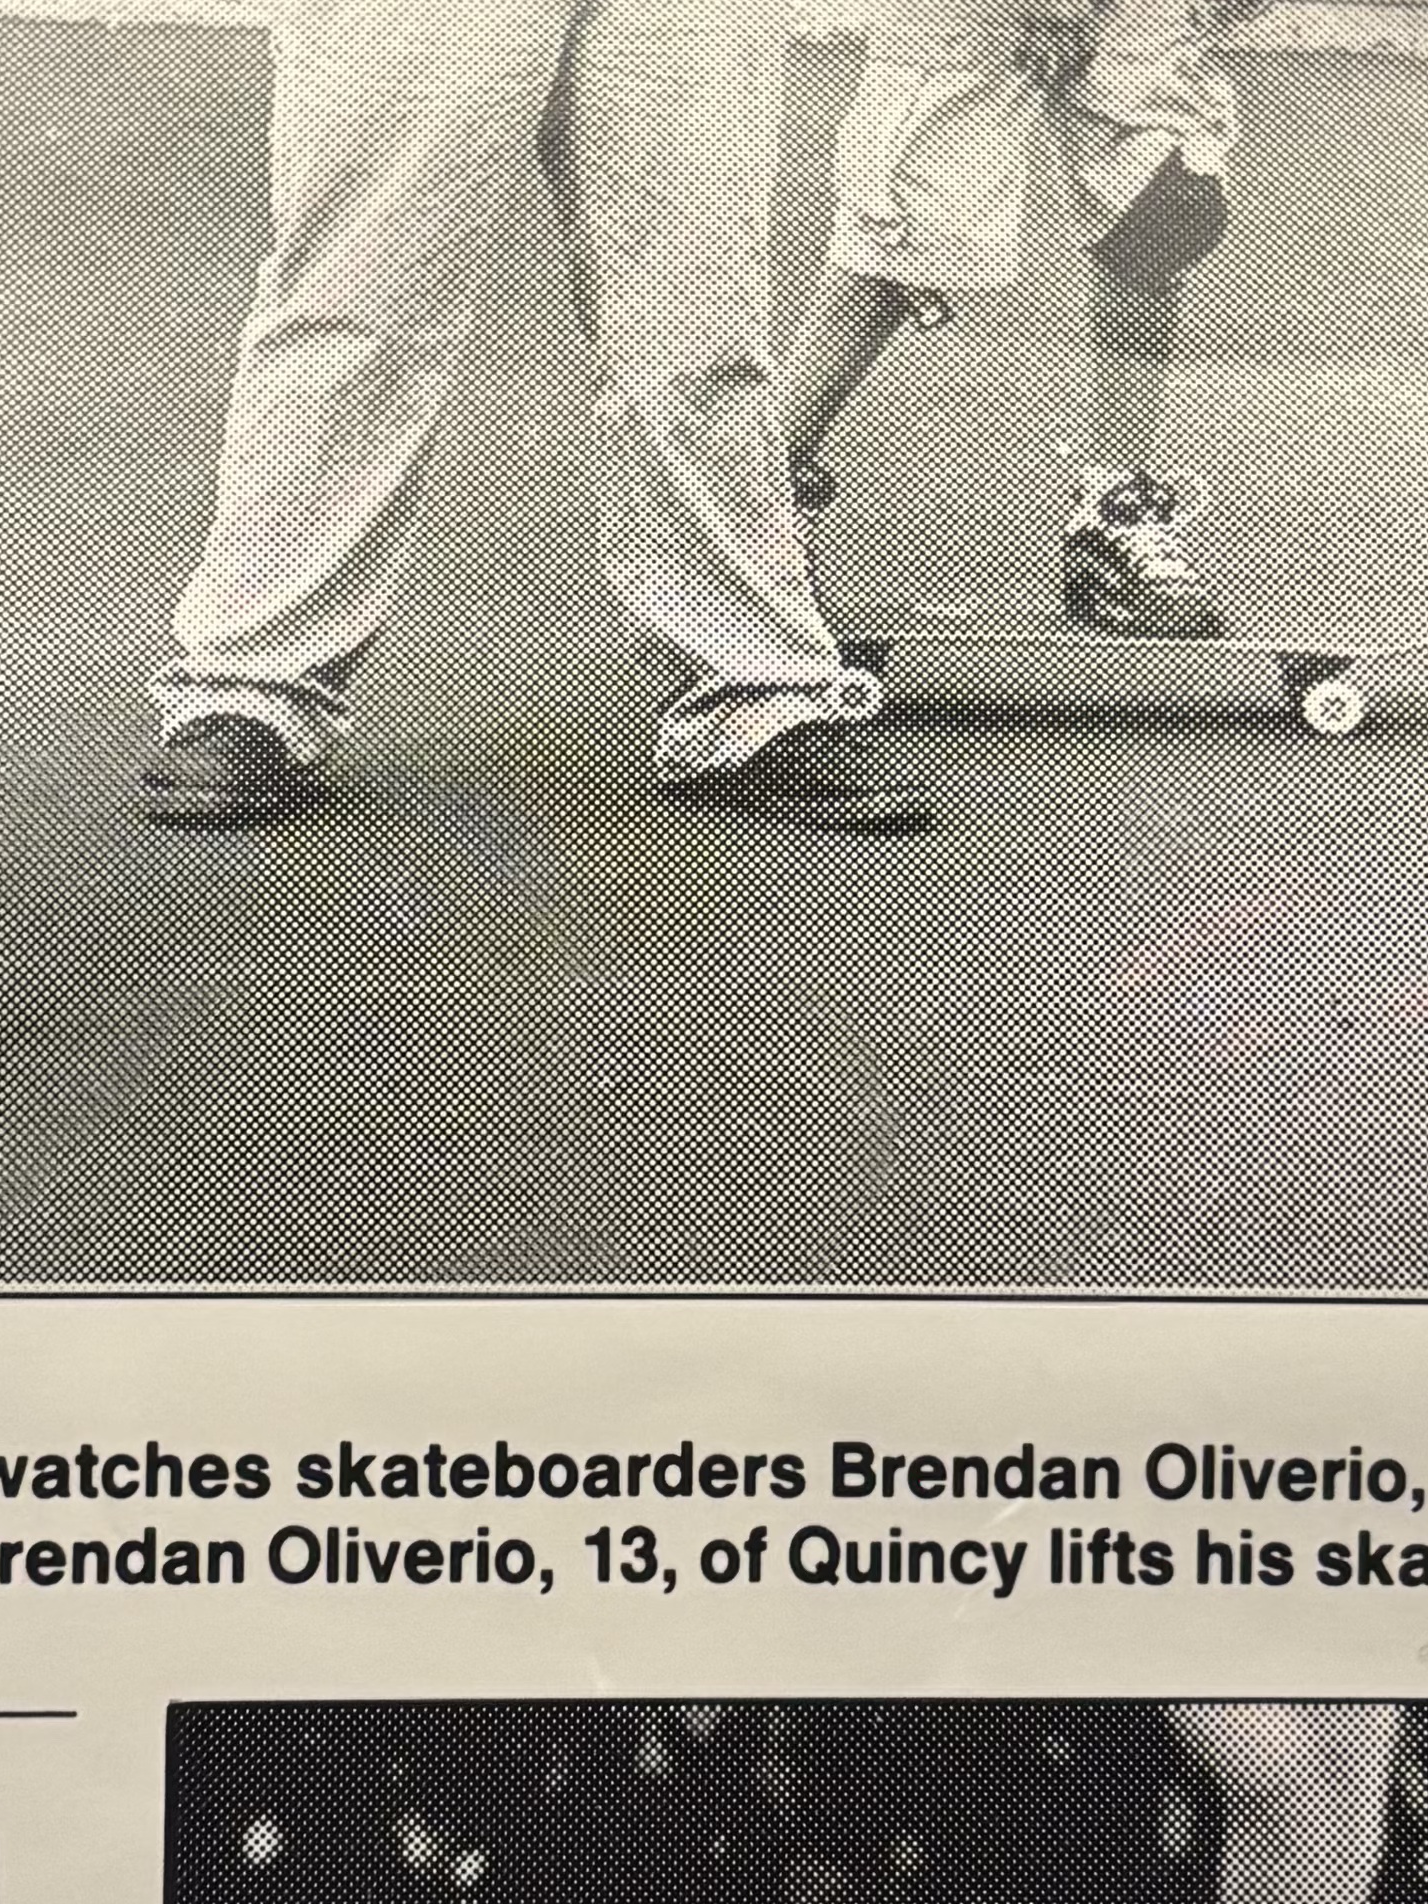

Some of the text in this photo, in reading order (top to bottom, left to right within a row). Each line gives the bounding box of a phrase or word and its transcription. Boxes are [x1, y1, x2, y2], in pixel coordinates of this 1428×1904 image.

[297, 1441, 806, 1499] skateboarders
[832, 1442, 1120, 1500] Brendan
[1146, 1442, 1425, 1512] Oliverio,
[269, 1525, 553, 1595] Oliverio,
[585, 1525, 676, 1595] 13,
[701, 1526, 767, 1585] of
[789, 1525, 1027, 1599] Quincy
[1051, 1528, 1174, 1586] lifts
[1197, 1529, 1294, 1587] his
